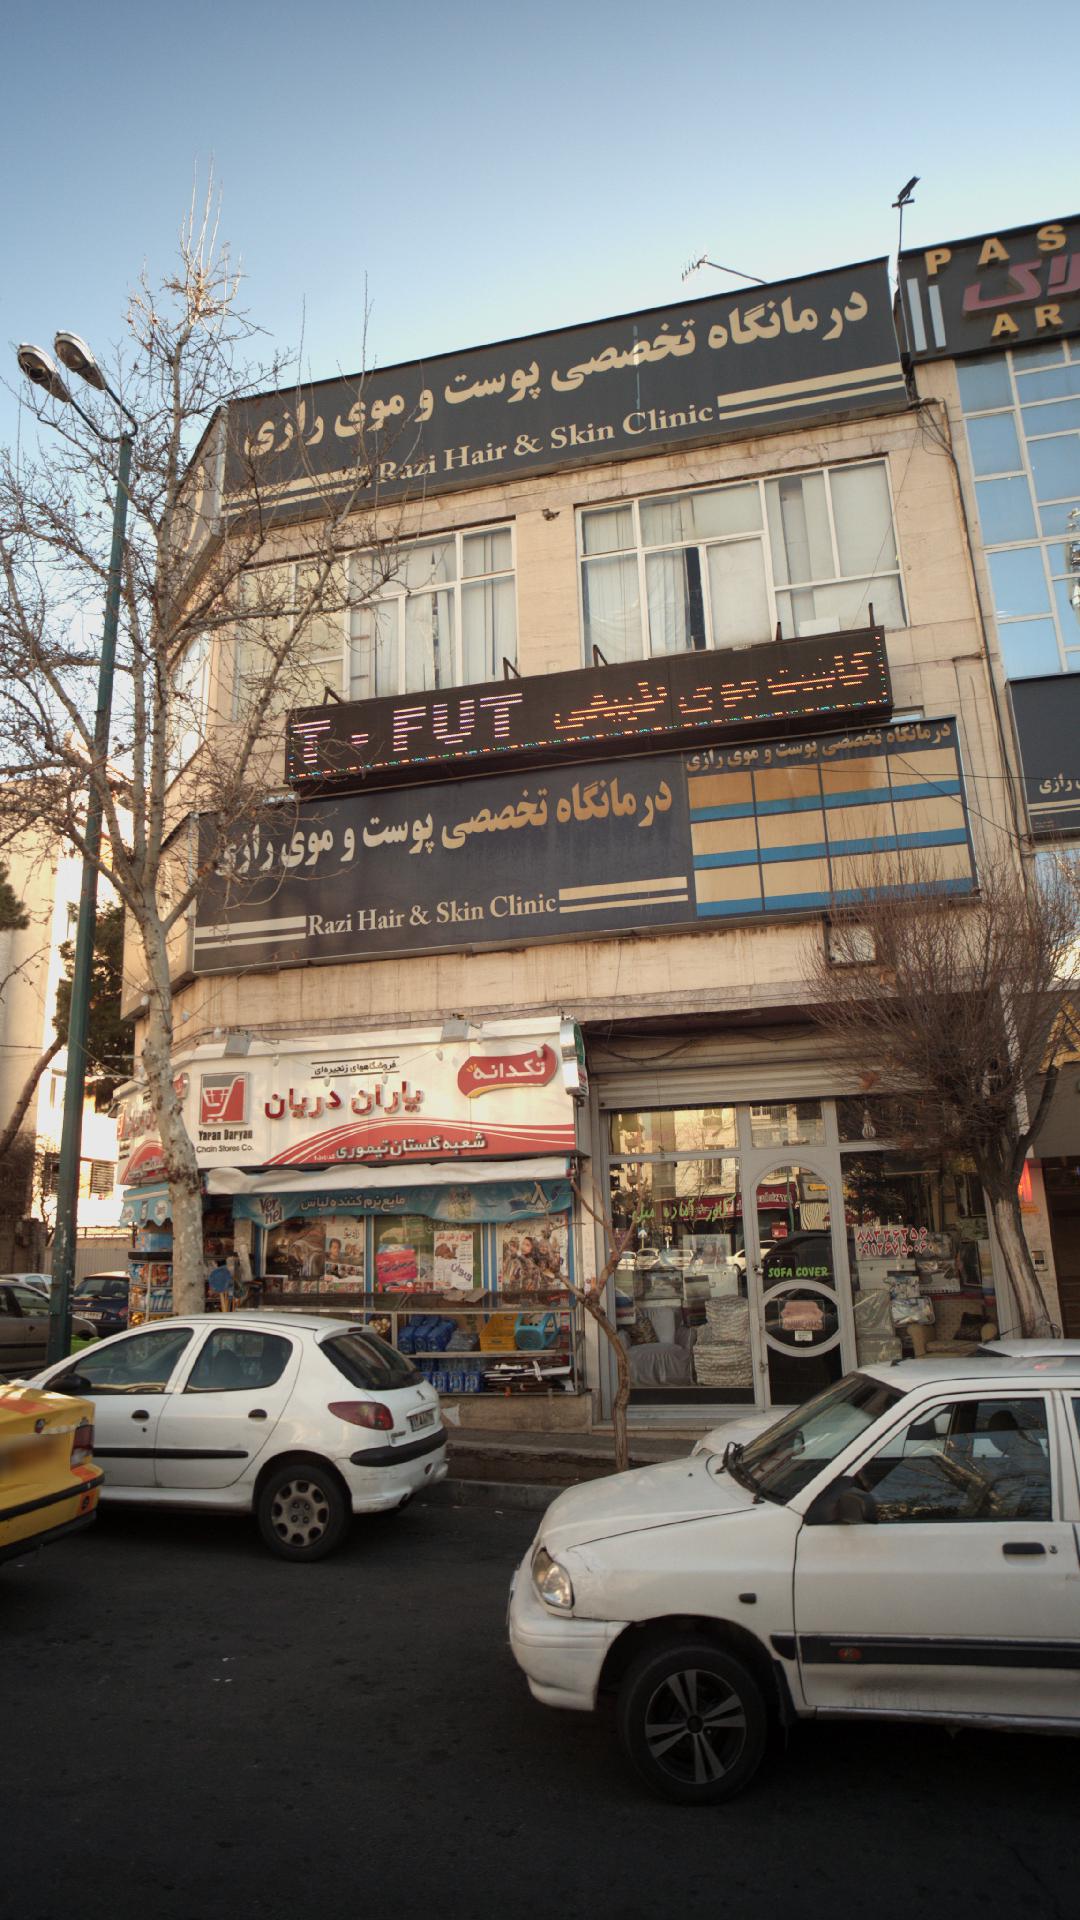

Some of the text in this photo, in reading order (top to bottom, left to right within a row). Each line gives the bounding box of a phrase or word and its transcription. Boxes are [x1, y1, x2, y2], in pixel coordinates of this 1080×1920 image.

[244, 290, 868, 457] درمانگاه تخصصی پوست و موی رازی
[377, 403, 713, 484] Razi Hair & Skin Clinic
[393, 693, 523, 751] FUT
[775, 741, 817, 759] پوست
[822, 729, 882, 756] تخصصی
[686, 748, 723, 772] رازی
[727, 747, 759, 768] موی
[764, 748, 771, 763] و
[1039, 773, 1072, 794] رازی
[216, 779, 672, 876] درمانگاه تخصصی پوست و موی رازی
[308, 894, 557, 937] Razi Hair & Skin Clinic
[473, 1059, 546, 1080] تکدانه
[265, 1081, 424, 1119] یاران دریان
[199, 1129, 253, 1141] Yaran Daryan
[336, 1132, 486, 1159] شعبه گلستان تیموری
[219, 1144, 239, 1152] Stores
[241, 1143, 254, 1151] Co.
[259, 1197, 279, 1213] Ver
[301, 1197, 329, 1211] لباس
[381, 1194, 406, 1212] مایع
[265, 1207, 283, 1224] nel
[768, 1266, 829, 1278] SOFA COVER
